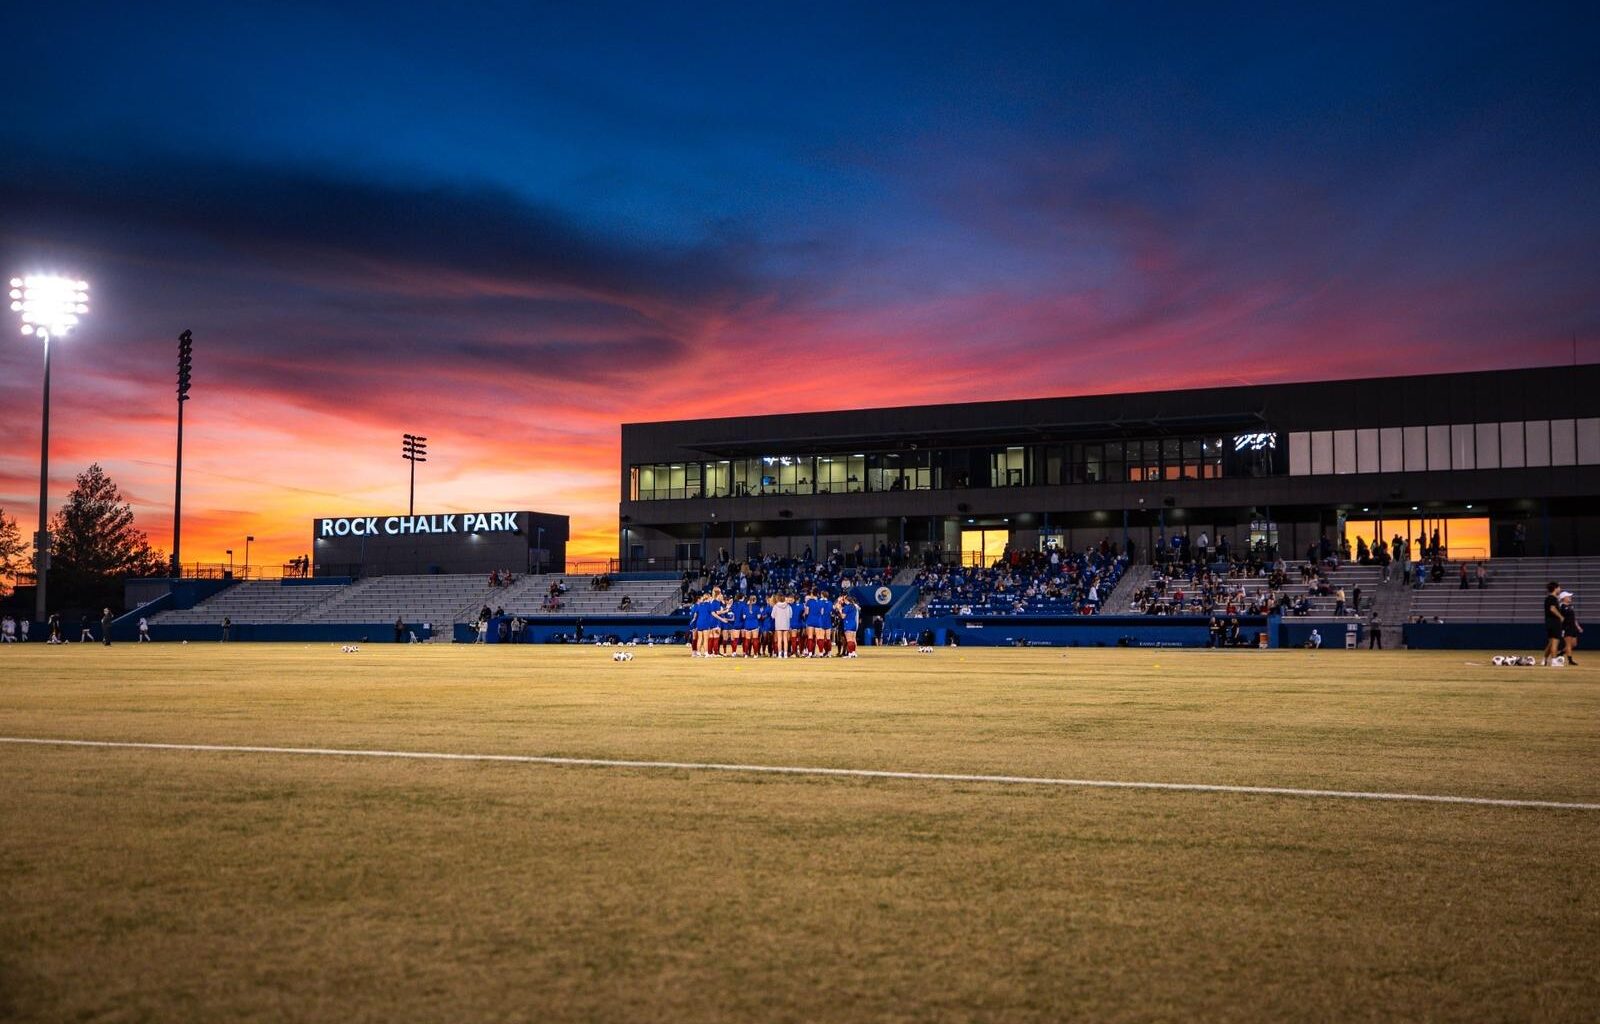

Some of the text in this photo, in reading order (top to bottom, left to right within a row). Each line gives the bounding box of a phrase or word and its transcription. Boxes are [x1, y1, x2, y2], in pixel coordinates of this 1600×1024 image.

[321, 512, 519, 536] ROCK CHALK PARK
